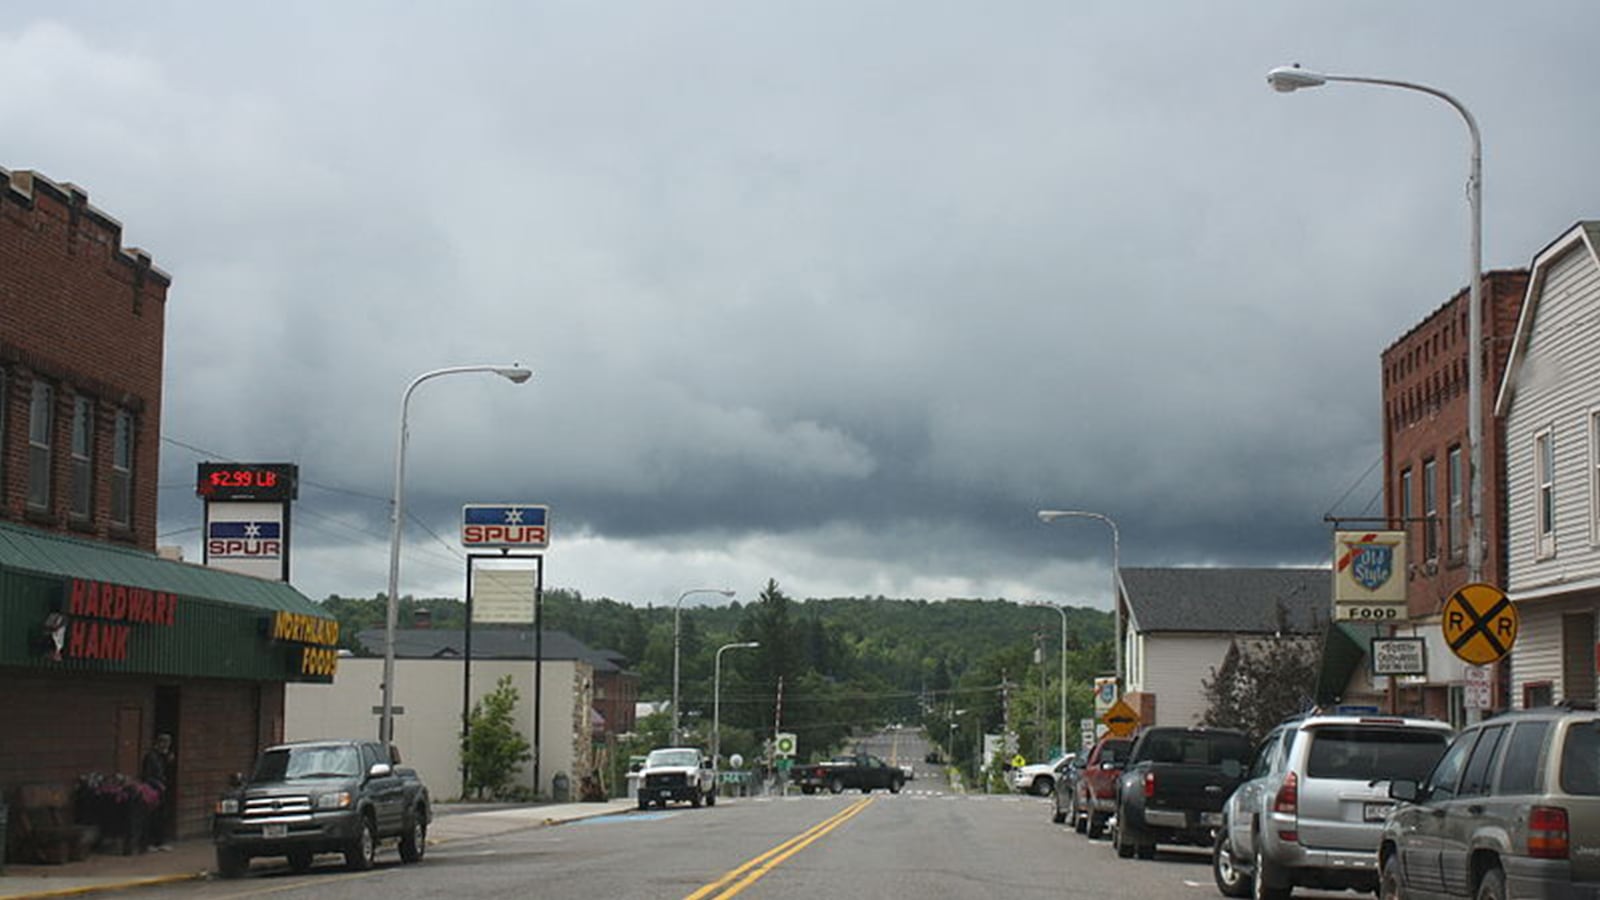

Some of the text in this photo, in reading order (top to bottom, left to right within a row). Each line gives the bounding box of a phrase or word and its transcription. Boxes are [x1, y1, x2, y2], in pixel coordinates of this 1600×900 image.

[210, 470, 277, 487] $2.99 LB
[464, 526, 545, 542] SPUR
[209, 540, 280, 555] SPUR
[1360, 548, 1385, 566] Old
[1354, 563, 1389, 587] Style
[70, 577, 178, 627] HARDWARE
[1349, 608, 1397, 619] FOOD
[275, 610, 338, 645] NORTHLAND
[1449, 611, 1512, 637] R R
[70, 621, 129, 659] HANK
[302, 647, 337, 674] FOODS
